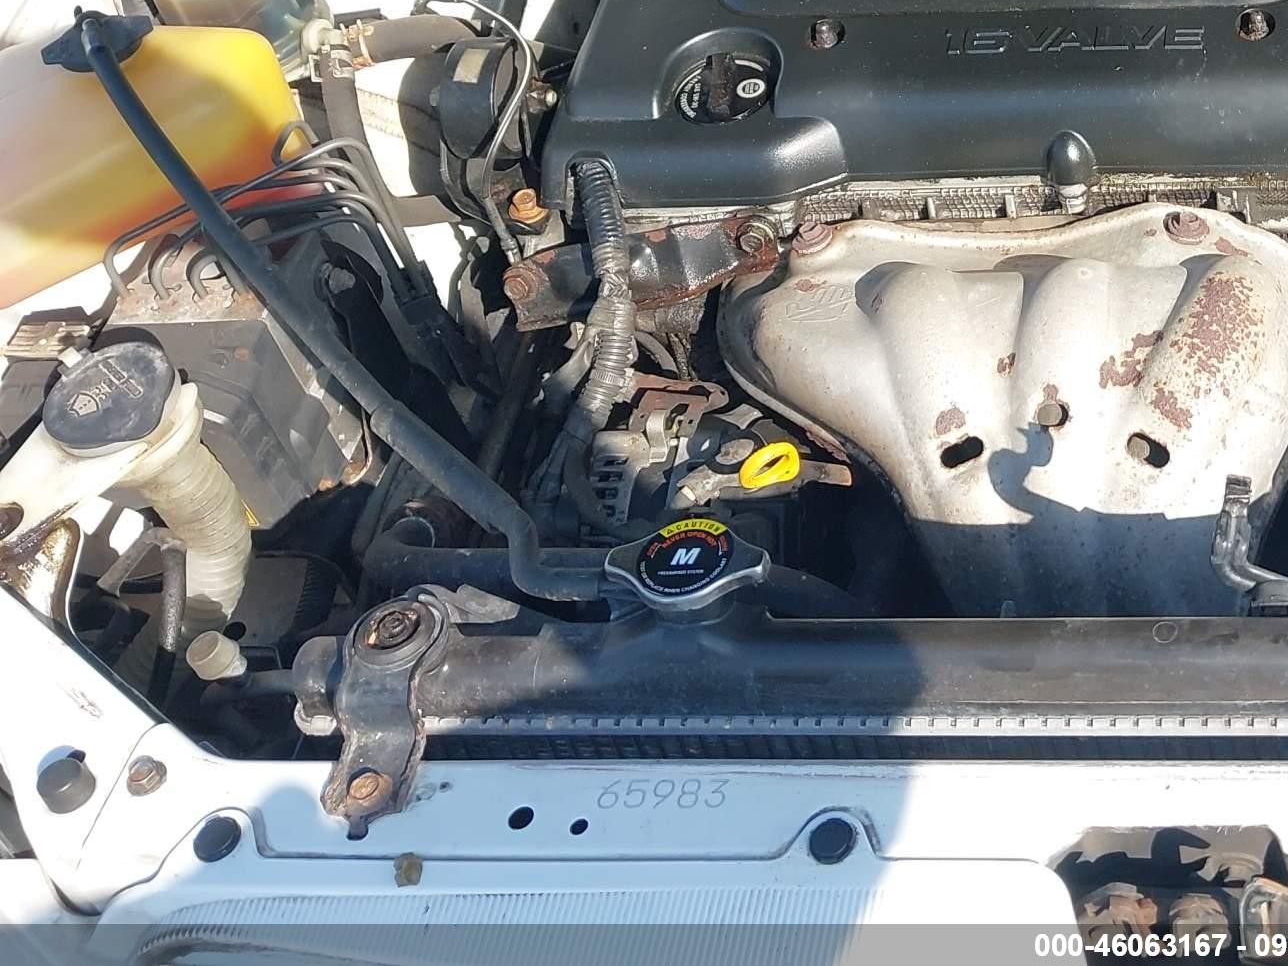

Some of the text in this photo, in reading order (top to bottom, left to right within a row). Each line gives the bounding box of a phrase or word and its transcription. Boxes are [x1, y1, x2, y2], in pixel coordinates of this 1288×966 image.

[1018, 25, 1206, 53] VALVE
[675, 521, 721, 533] CAUTION
[670, 547, 702, 566] M
[596, 778, 731, 810] 65983
